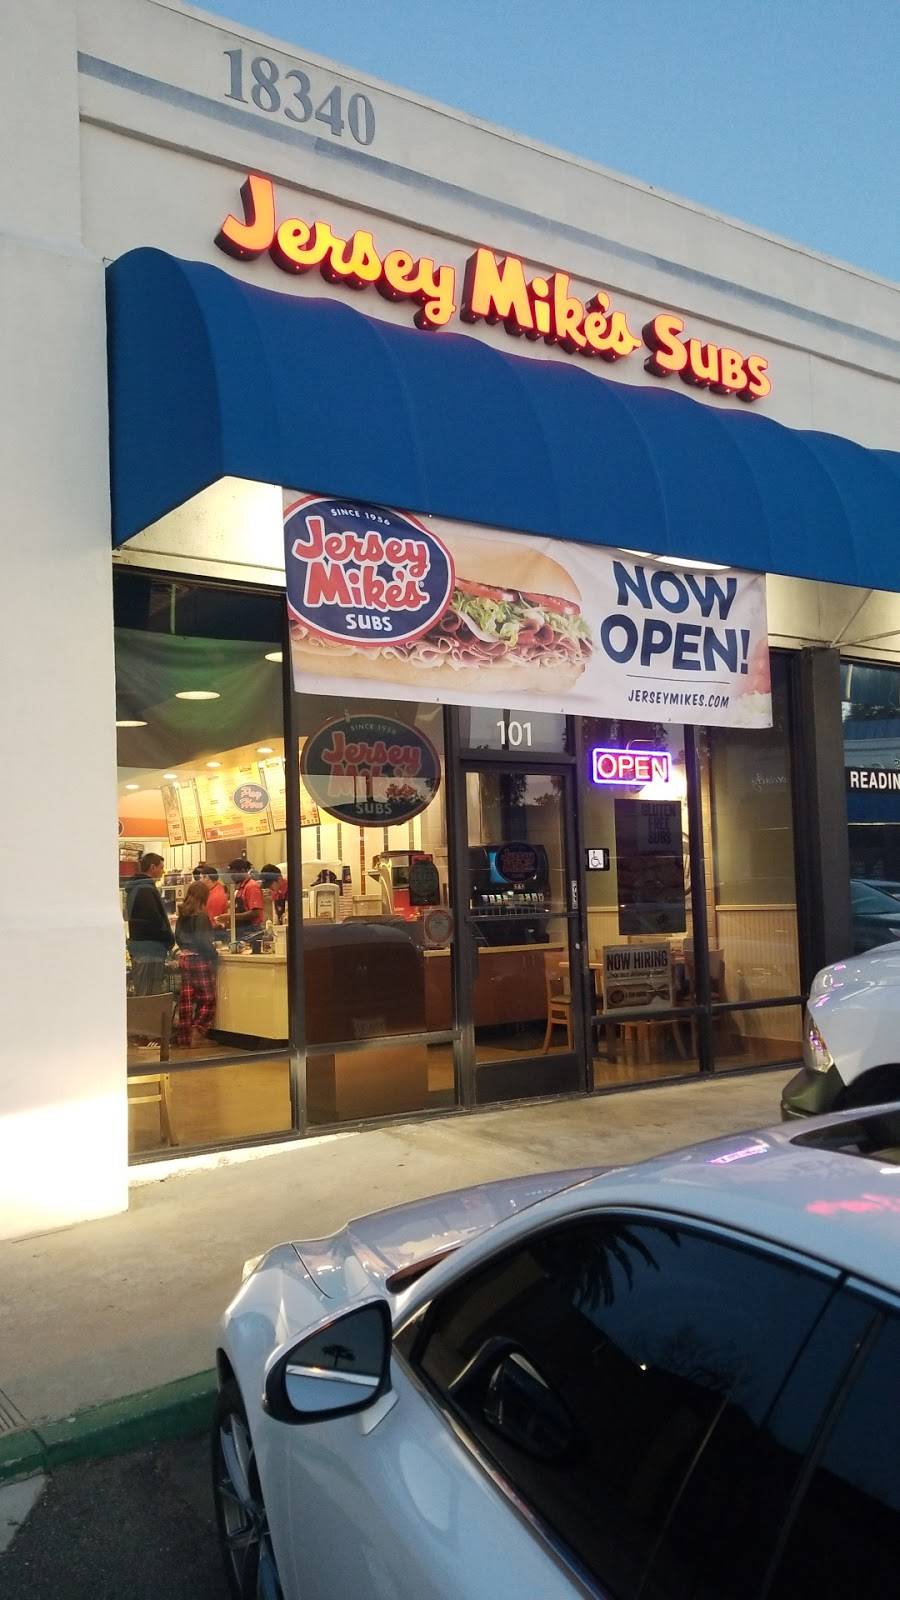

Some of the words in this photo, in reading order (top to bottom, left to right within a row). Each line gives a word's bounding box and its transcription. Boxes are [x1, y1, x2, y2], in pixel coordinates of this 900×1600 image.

[223, 48, 376, 146] 18340
[215, 173, 456, 328] Jersey
[463, 246, 642, 361] Mike's
[330, 508, 361, 518] SINCE
[364, 512, 392, 526] 1956
[292, 515, 431, 579] Jersey
[304, 560, 430, 612] Mike's
[612, 560, 737, 621] NOW
[345, 613, 393, 632] SUBS
[600, 613, 751, 675] OPEN!
[628, 689, 730, 709] JERSEYMIKES.COM
[496, 720, 533, 746] 101
[321, 731, 422, 777] Jersey
[597, 753, 669, 780] OPEN
[355, 802, 393, 815] SUBS
[606, 952, 631, 971] NOW
[633, 950, 668, 969] HIRING
